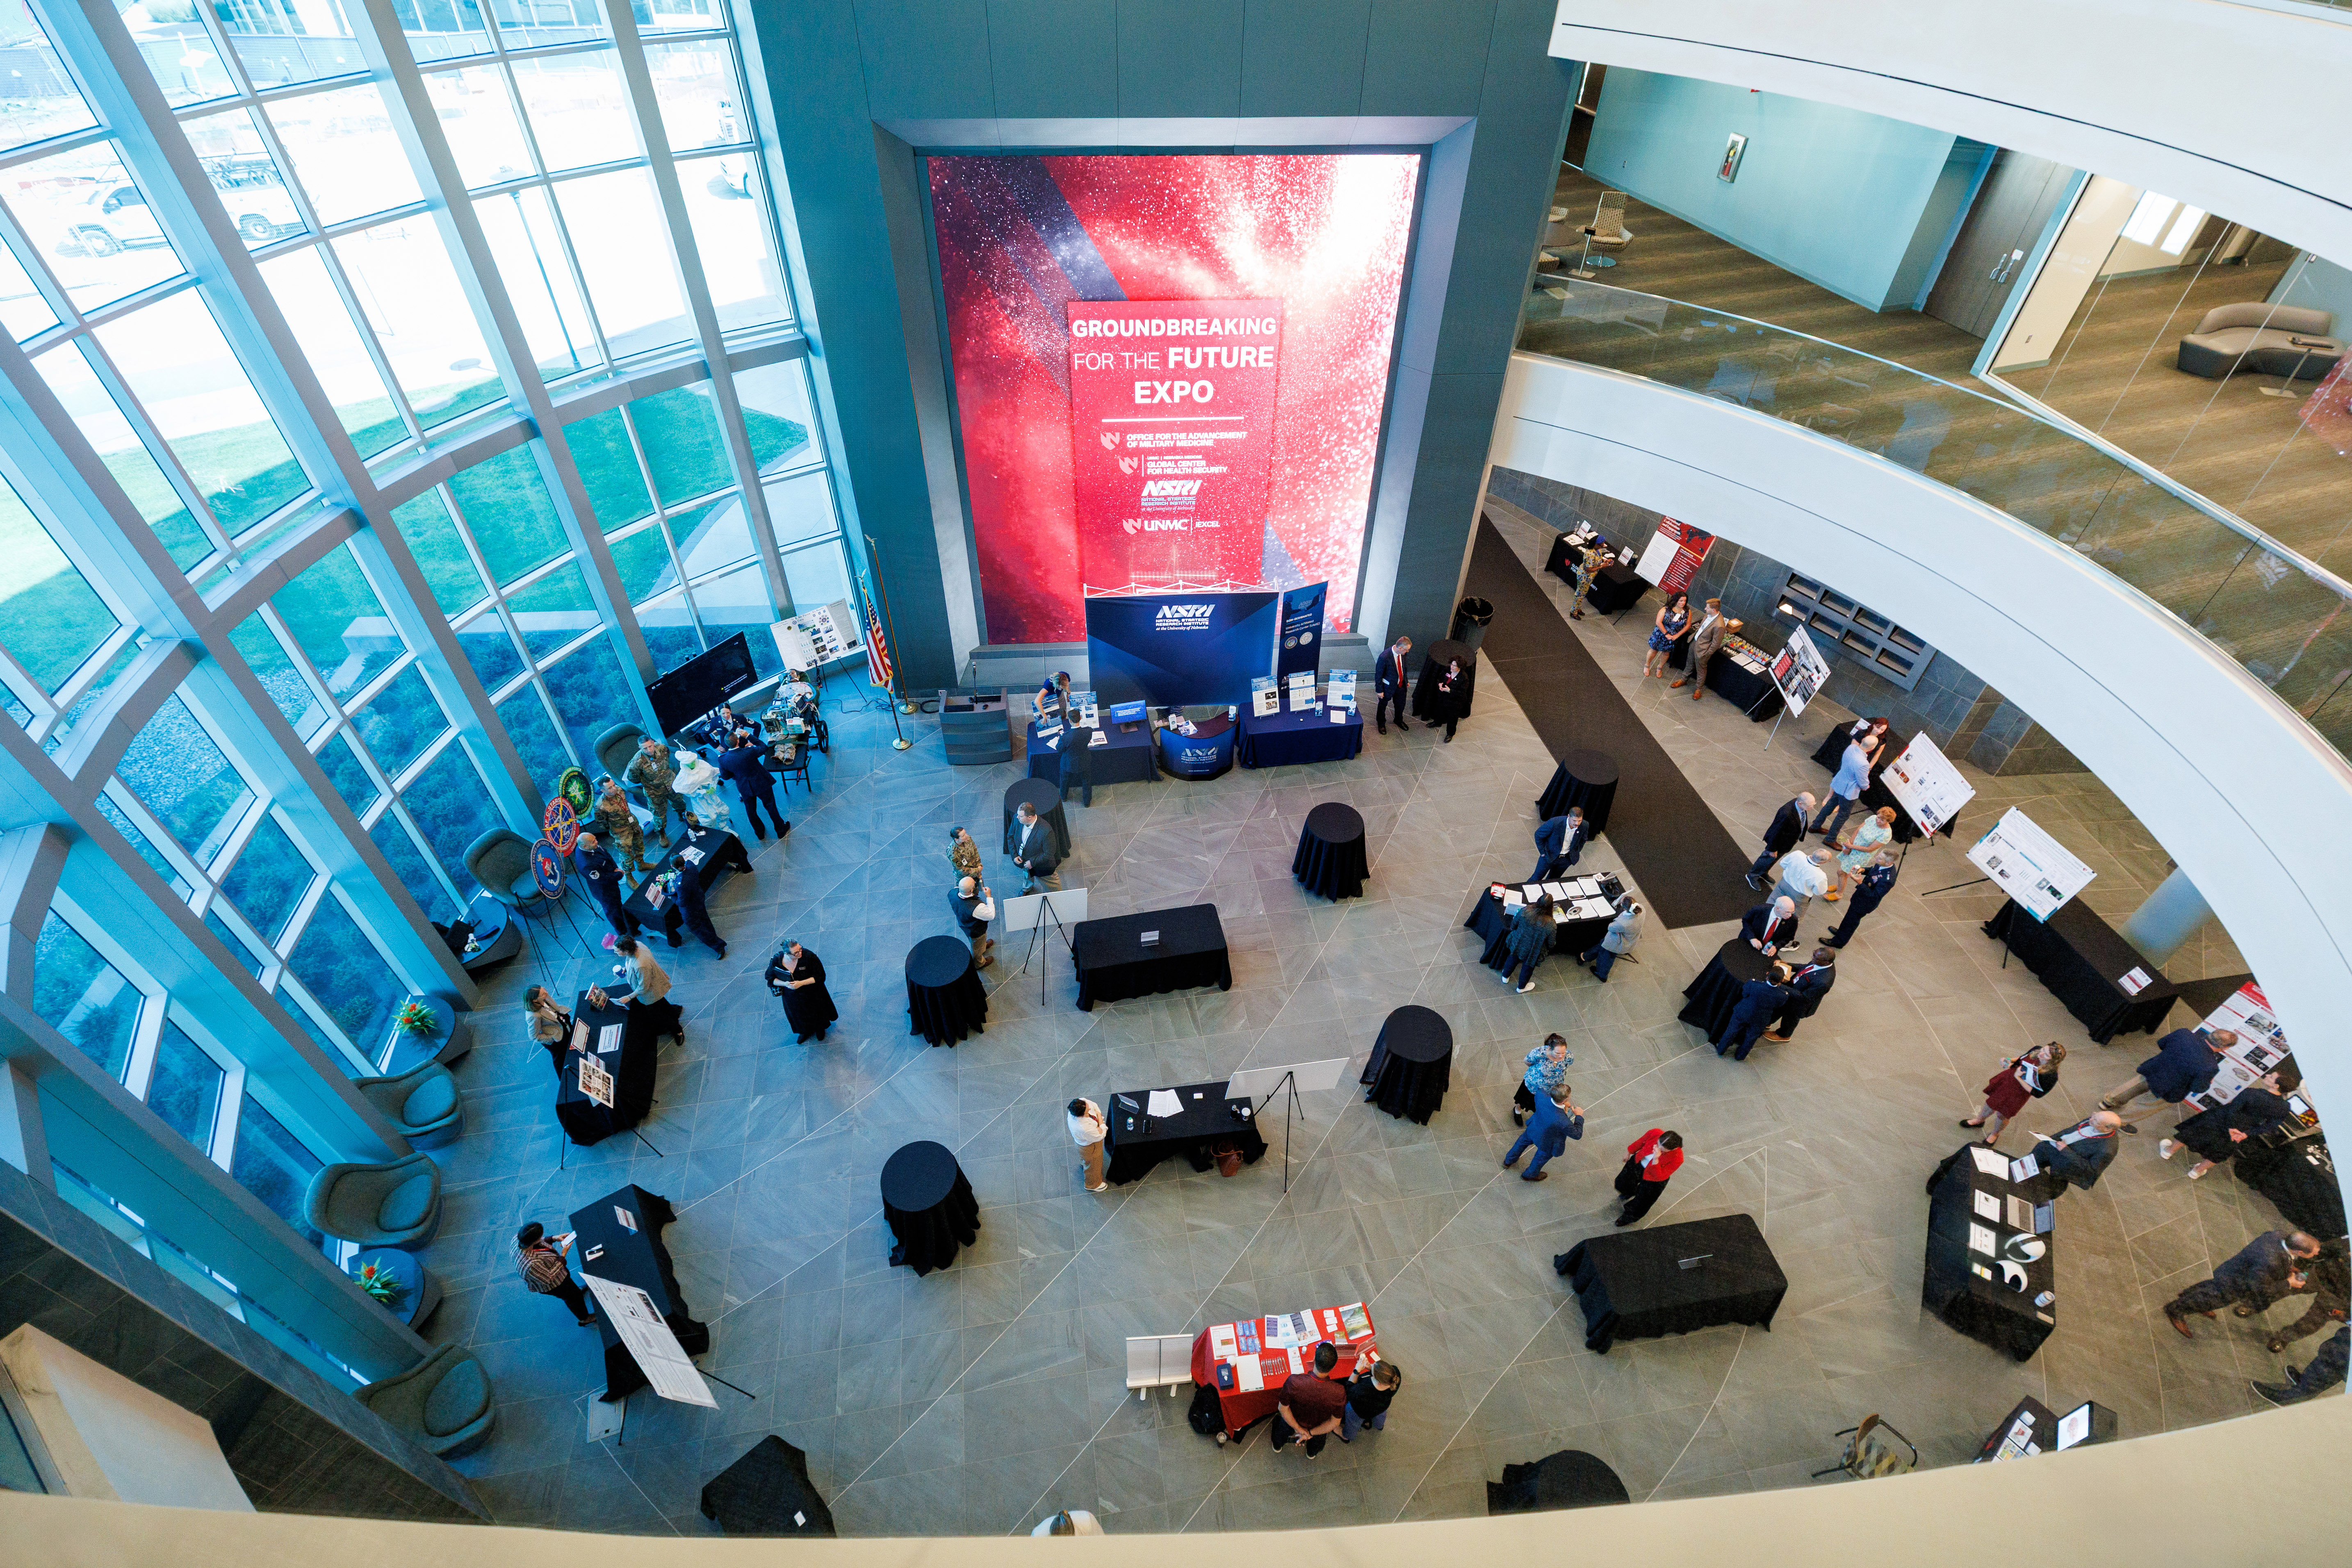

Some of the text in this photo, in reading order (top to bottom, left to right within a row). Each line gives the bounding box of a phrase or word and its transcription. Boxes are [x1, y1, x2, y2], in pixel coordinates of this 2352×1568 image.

[1072, 317, 1276, 337] GROUNDBREAKING
[1074, 346, 1274, 370] FOR THE FUTURE
[1135, 380, 1214, 403] EXPO
[1141, 480, 1202, 496] NSRI
[1144, 520, 1190, 531] UNMC
[1156, 604, 1215, 618] NSRI
[545, 820, 549, 828] AF
